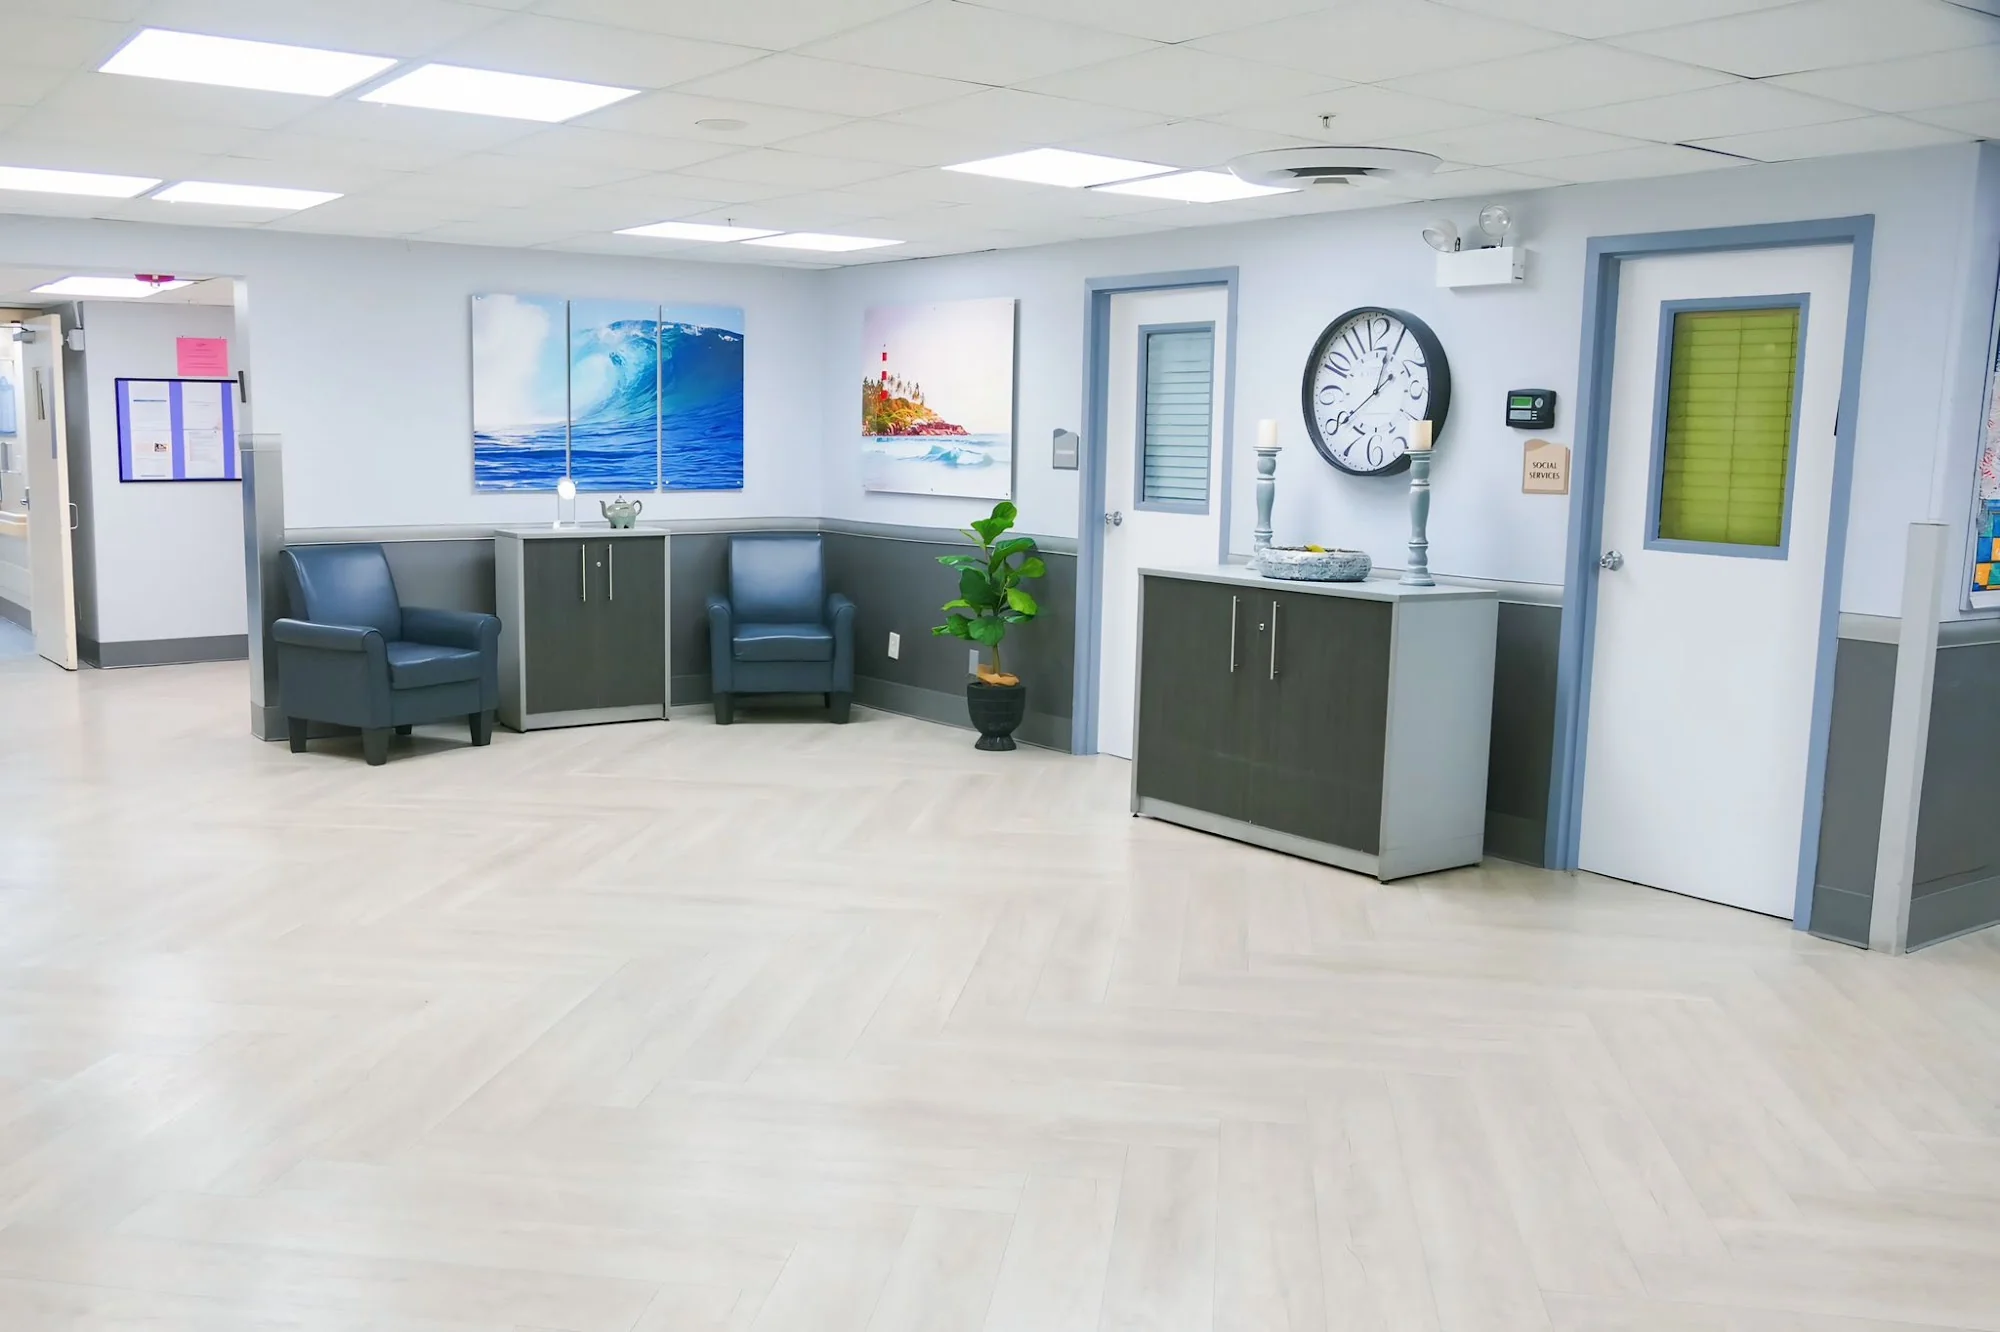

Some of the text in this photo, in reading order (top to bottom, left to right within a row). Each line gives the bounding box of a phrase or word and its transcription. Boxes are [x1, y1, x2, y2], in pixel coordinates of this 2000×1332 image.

[1342, 326, 1366, 359] 11
[1366, 317, 1390, 351] 12
[1392, 325, 1407, 355] 1
[1324, 351, 1350, 378] 10
[1402, 347, 1427, 377] 2
[1319, 384, 1344, 405] 9
[1409, 379, 1429, 399] 3
[1325, 410, 1349, 435] 8
[1343, 425, 1365, 457] 7
[1366, 434, 1384, 466] 6
[1529, 472, 1560, 480] SERVICES
[1532, 461, 1557, 469] SOCIAL
